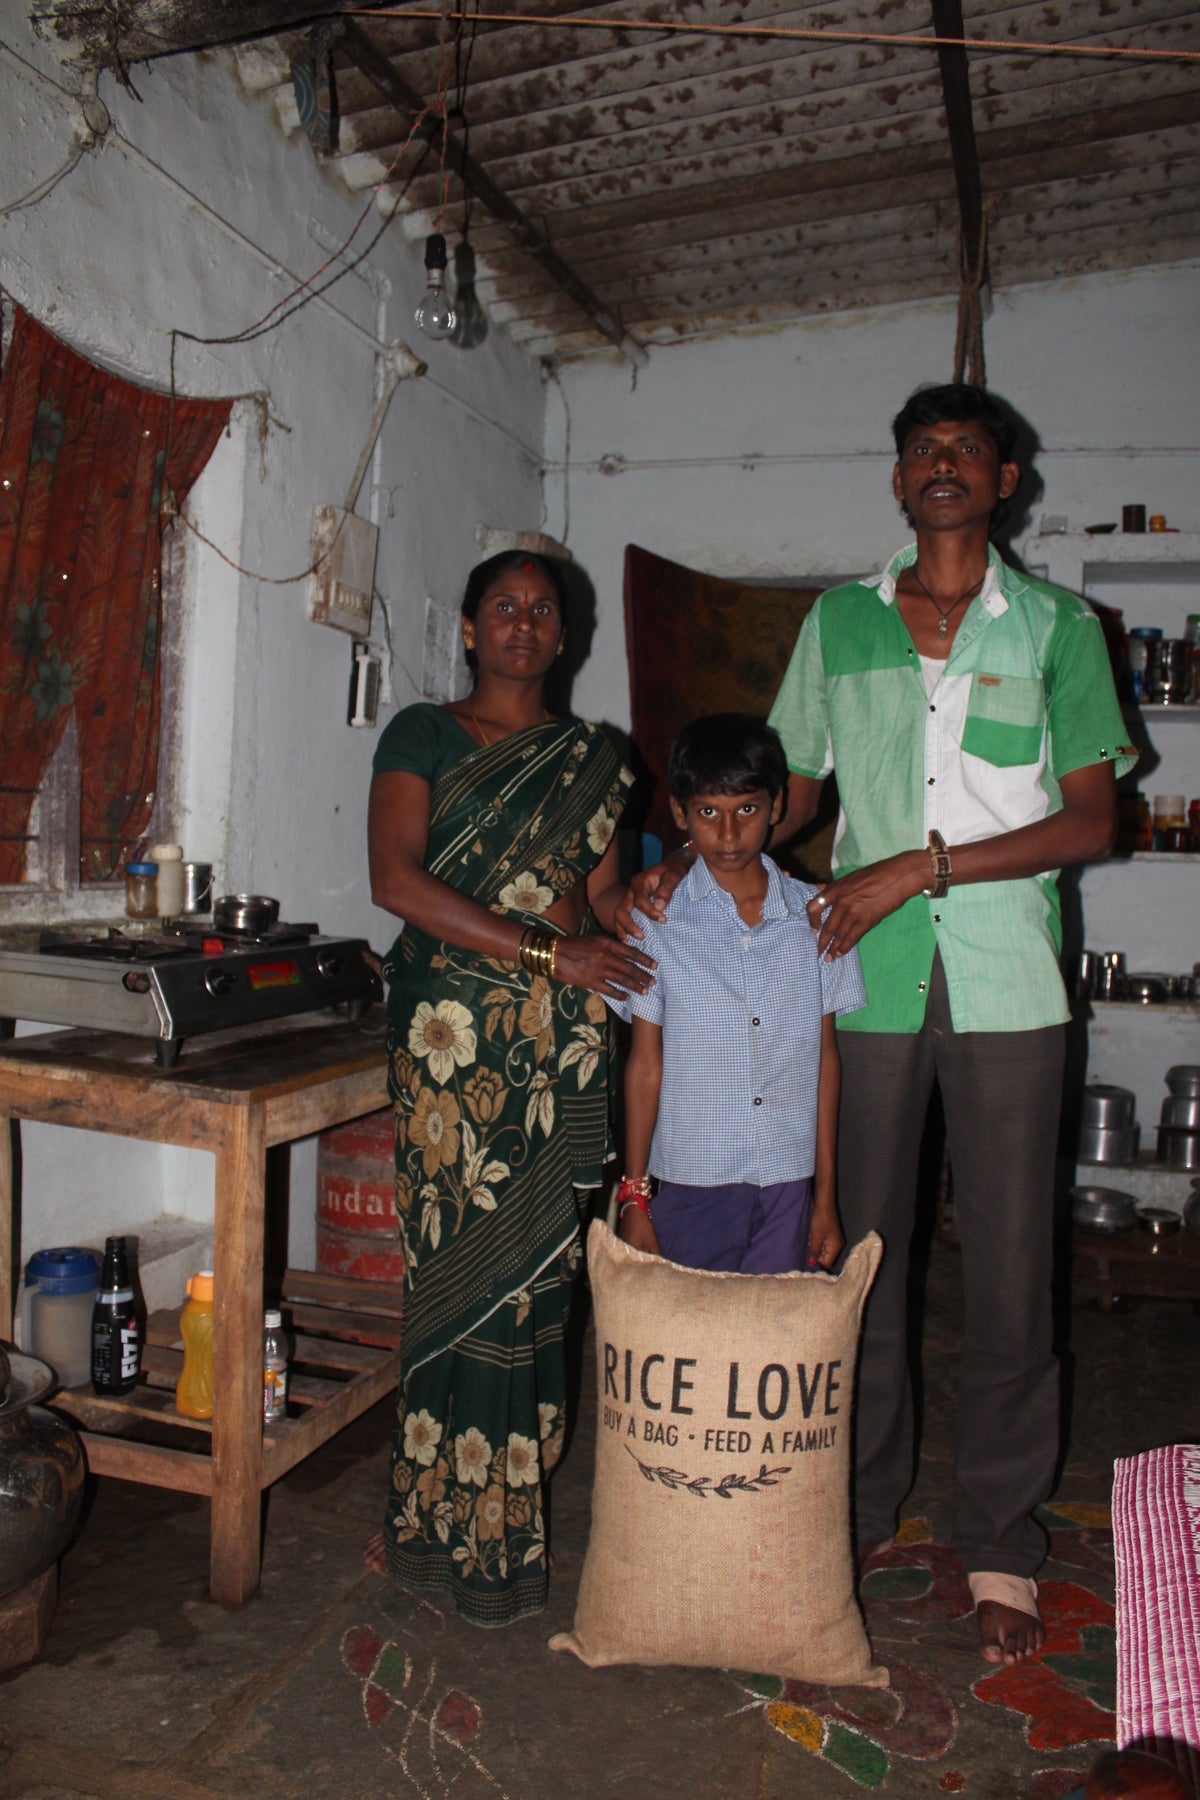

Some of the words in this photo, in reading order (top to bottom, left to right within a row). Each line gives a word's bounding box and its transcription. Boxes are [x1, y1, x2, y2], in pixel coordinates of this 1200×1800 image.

[604, 1342, 697, 1415] RICE
[727, 1360, 841, 1421] LOVE
[604, 1405, 622, 1432] BUY
[627, 1417, 636, 1438] A
[644, 1422, 678, 1447] BAG
[704, 1429, 751, 1453] FEED
[761, 1432, 774, 1454] A
[782, 1426, 837, 1453] FAMILY
